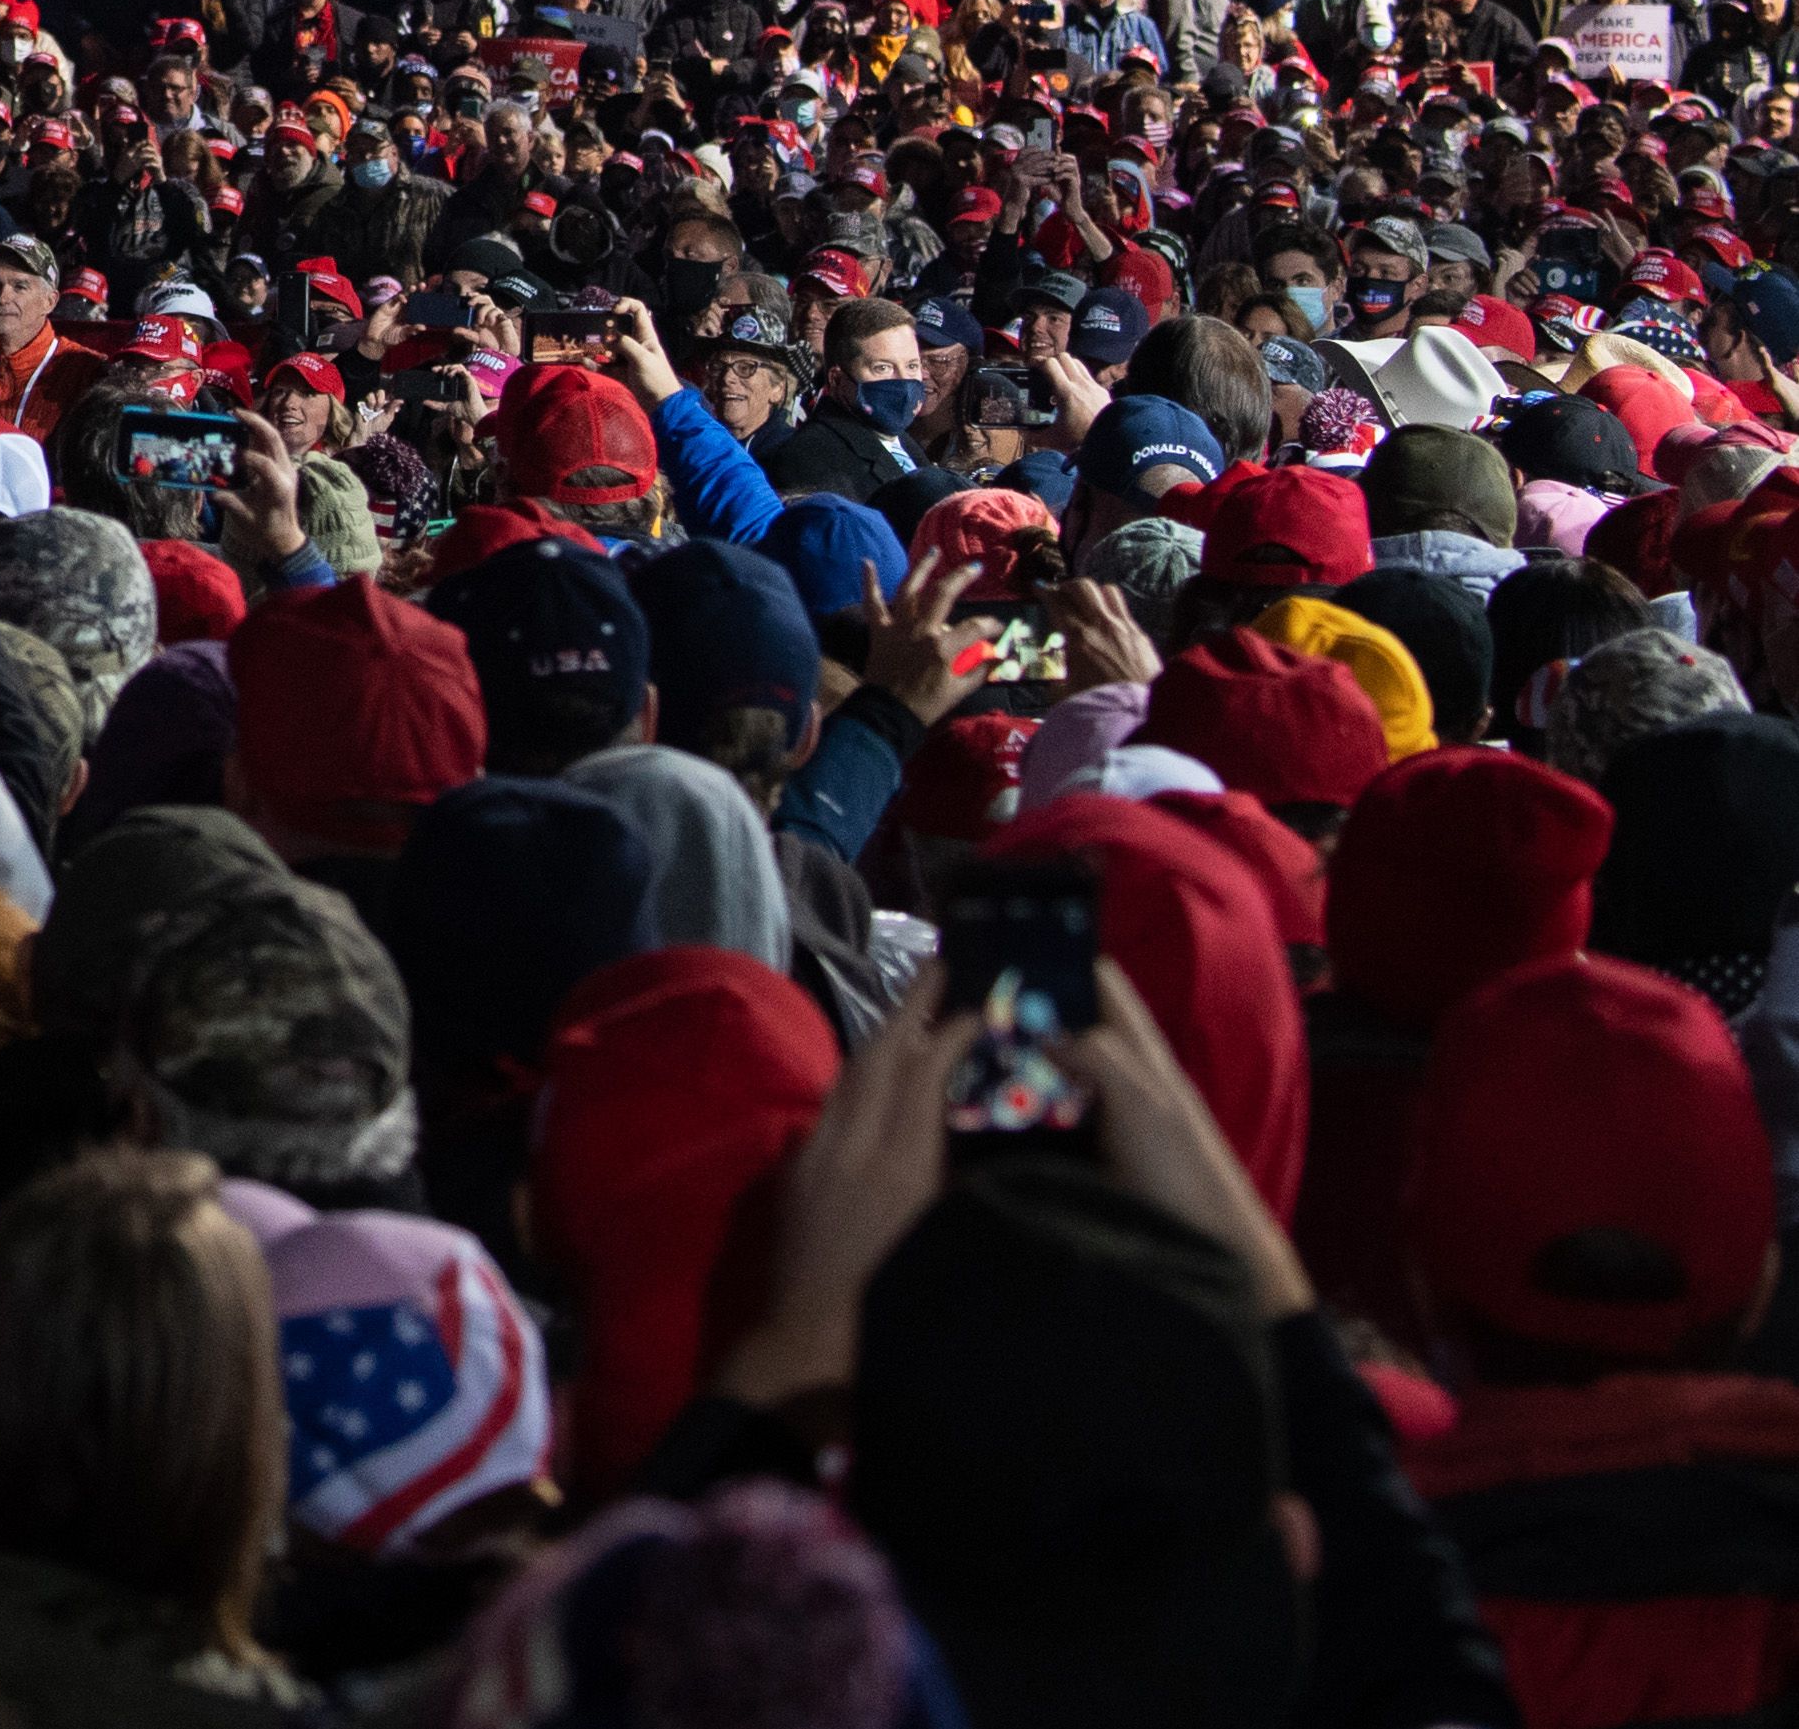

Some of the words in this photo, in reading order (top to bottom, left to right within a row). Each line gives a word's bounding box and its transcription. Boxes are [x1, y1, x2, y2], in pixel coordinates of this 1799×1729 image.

[1592, 17, 1634, 29] MAKE
[1569, 31, 1661, 49] AMERICA
[1576, 52, 1611, 64] REAT
[1616, 51, 1662, 64] AGAIN
[1132, 443, 1187, 465] DONALD
